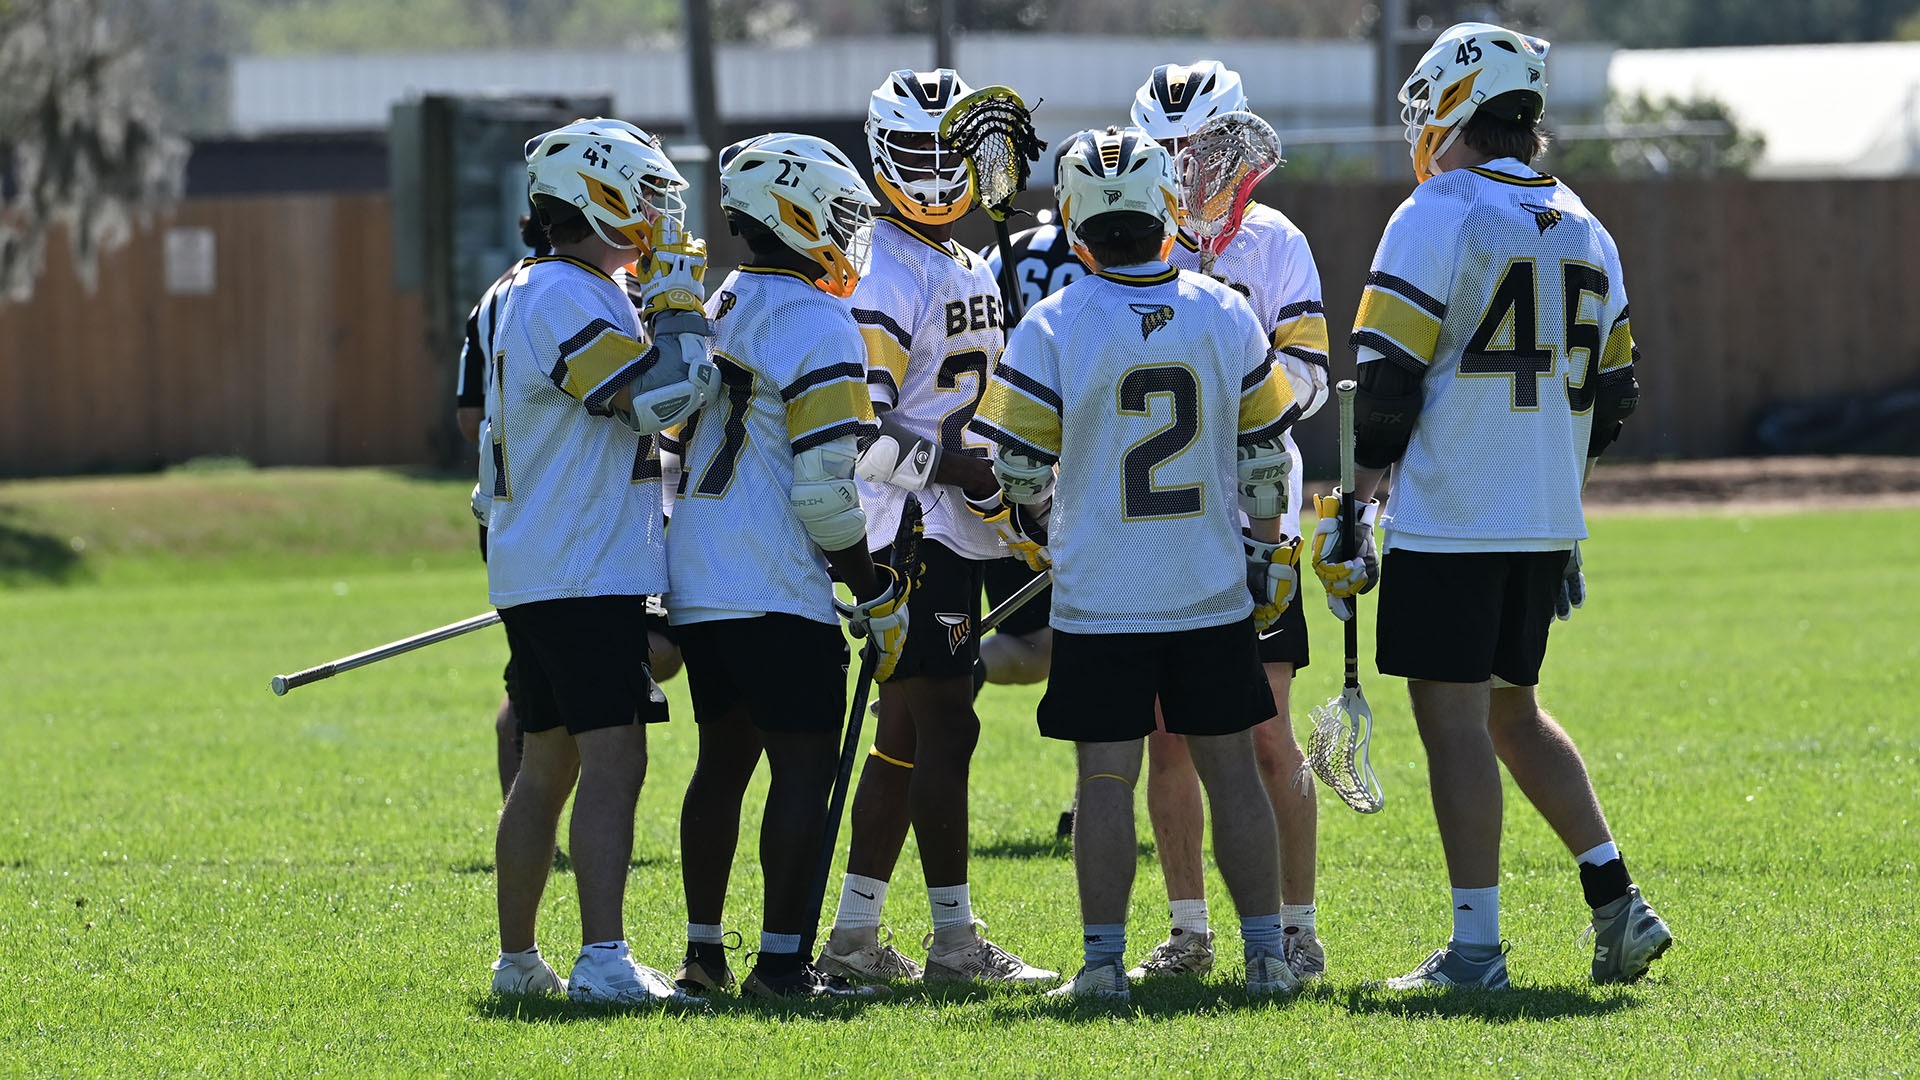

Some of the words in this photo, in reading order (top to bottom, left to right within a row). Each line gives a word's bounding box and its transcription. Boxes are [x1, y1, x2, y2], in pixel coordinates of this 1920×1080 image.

[1455, 37, 1483, 66] 45
[774, 159, 807, 188] 27
[1455, 256, 1610, 417] 45
[934, 346, 1004, 460] 2
[675, 350, 758, 500] 7
[1369, 411, 1405, 425] STX
[1116, 361, 1205, 523] 2
[1248, 461, 1287, 481] STX
[791, 498, 825, 507] ERIK
